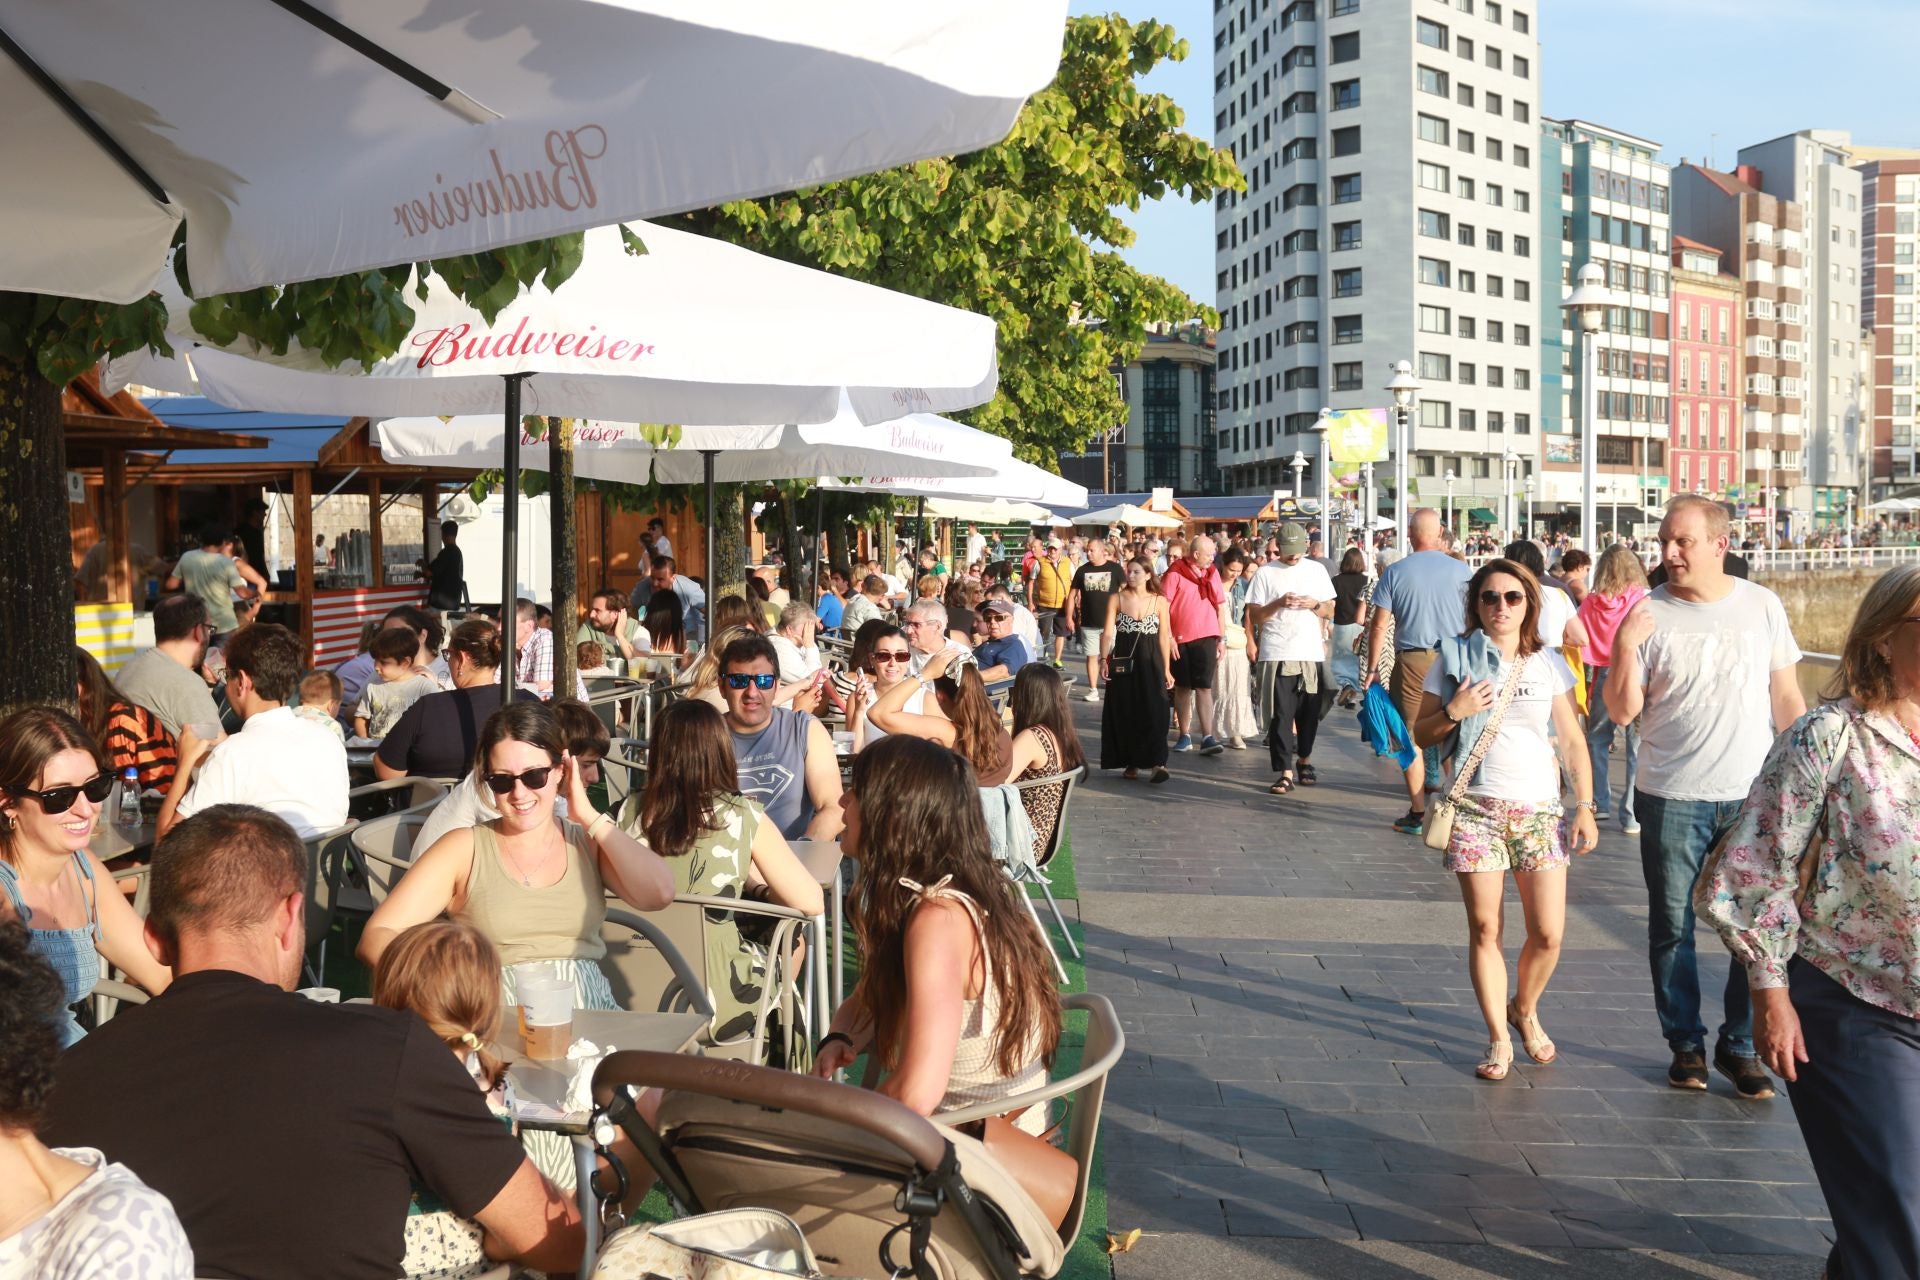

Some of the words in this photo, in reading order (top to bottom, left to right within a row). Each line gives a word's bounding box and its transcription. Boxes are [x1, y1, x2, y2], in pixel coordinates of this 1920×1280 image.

[411, 316, 656, 369] Budweiser
[520, 421, 625, 446] Bweiser
[888, 424, 945, 454] Budweiser
